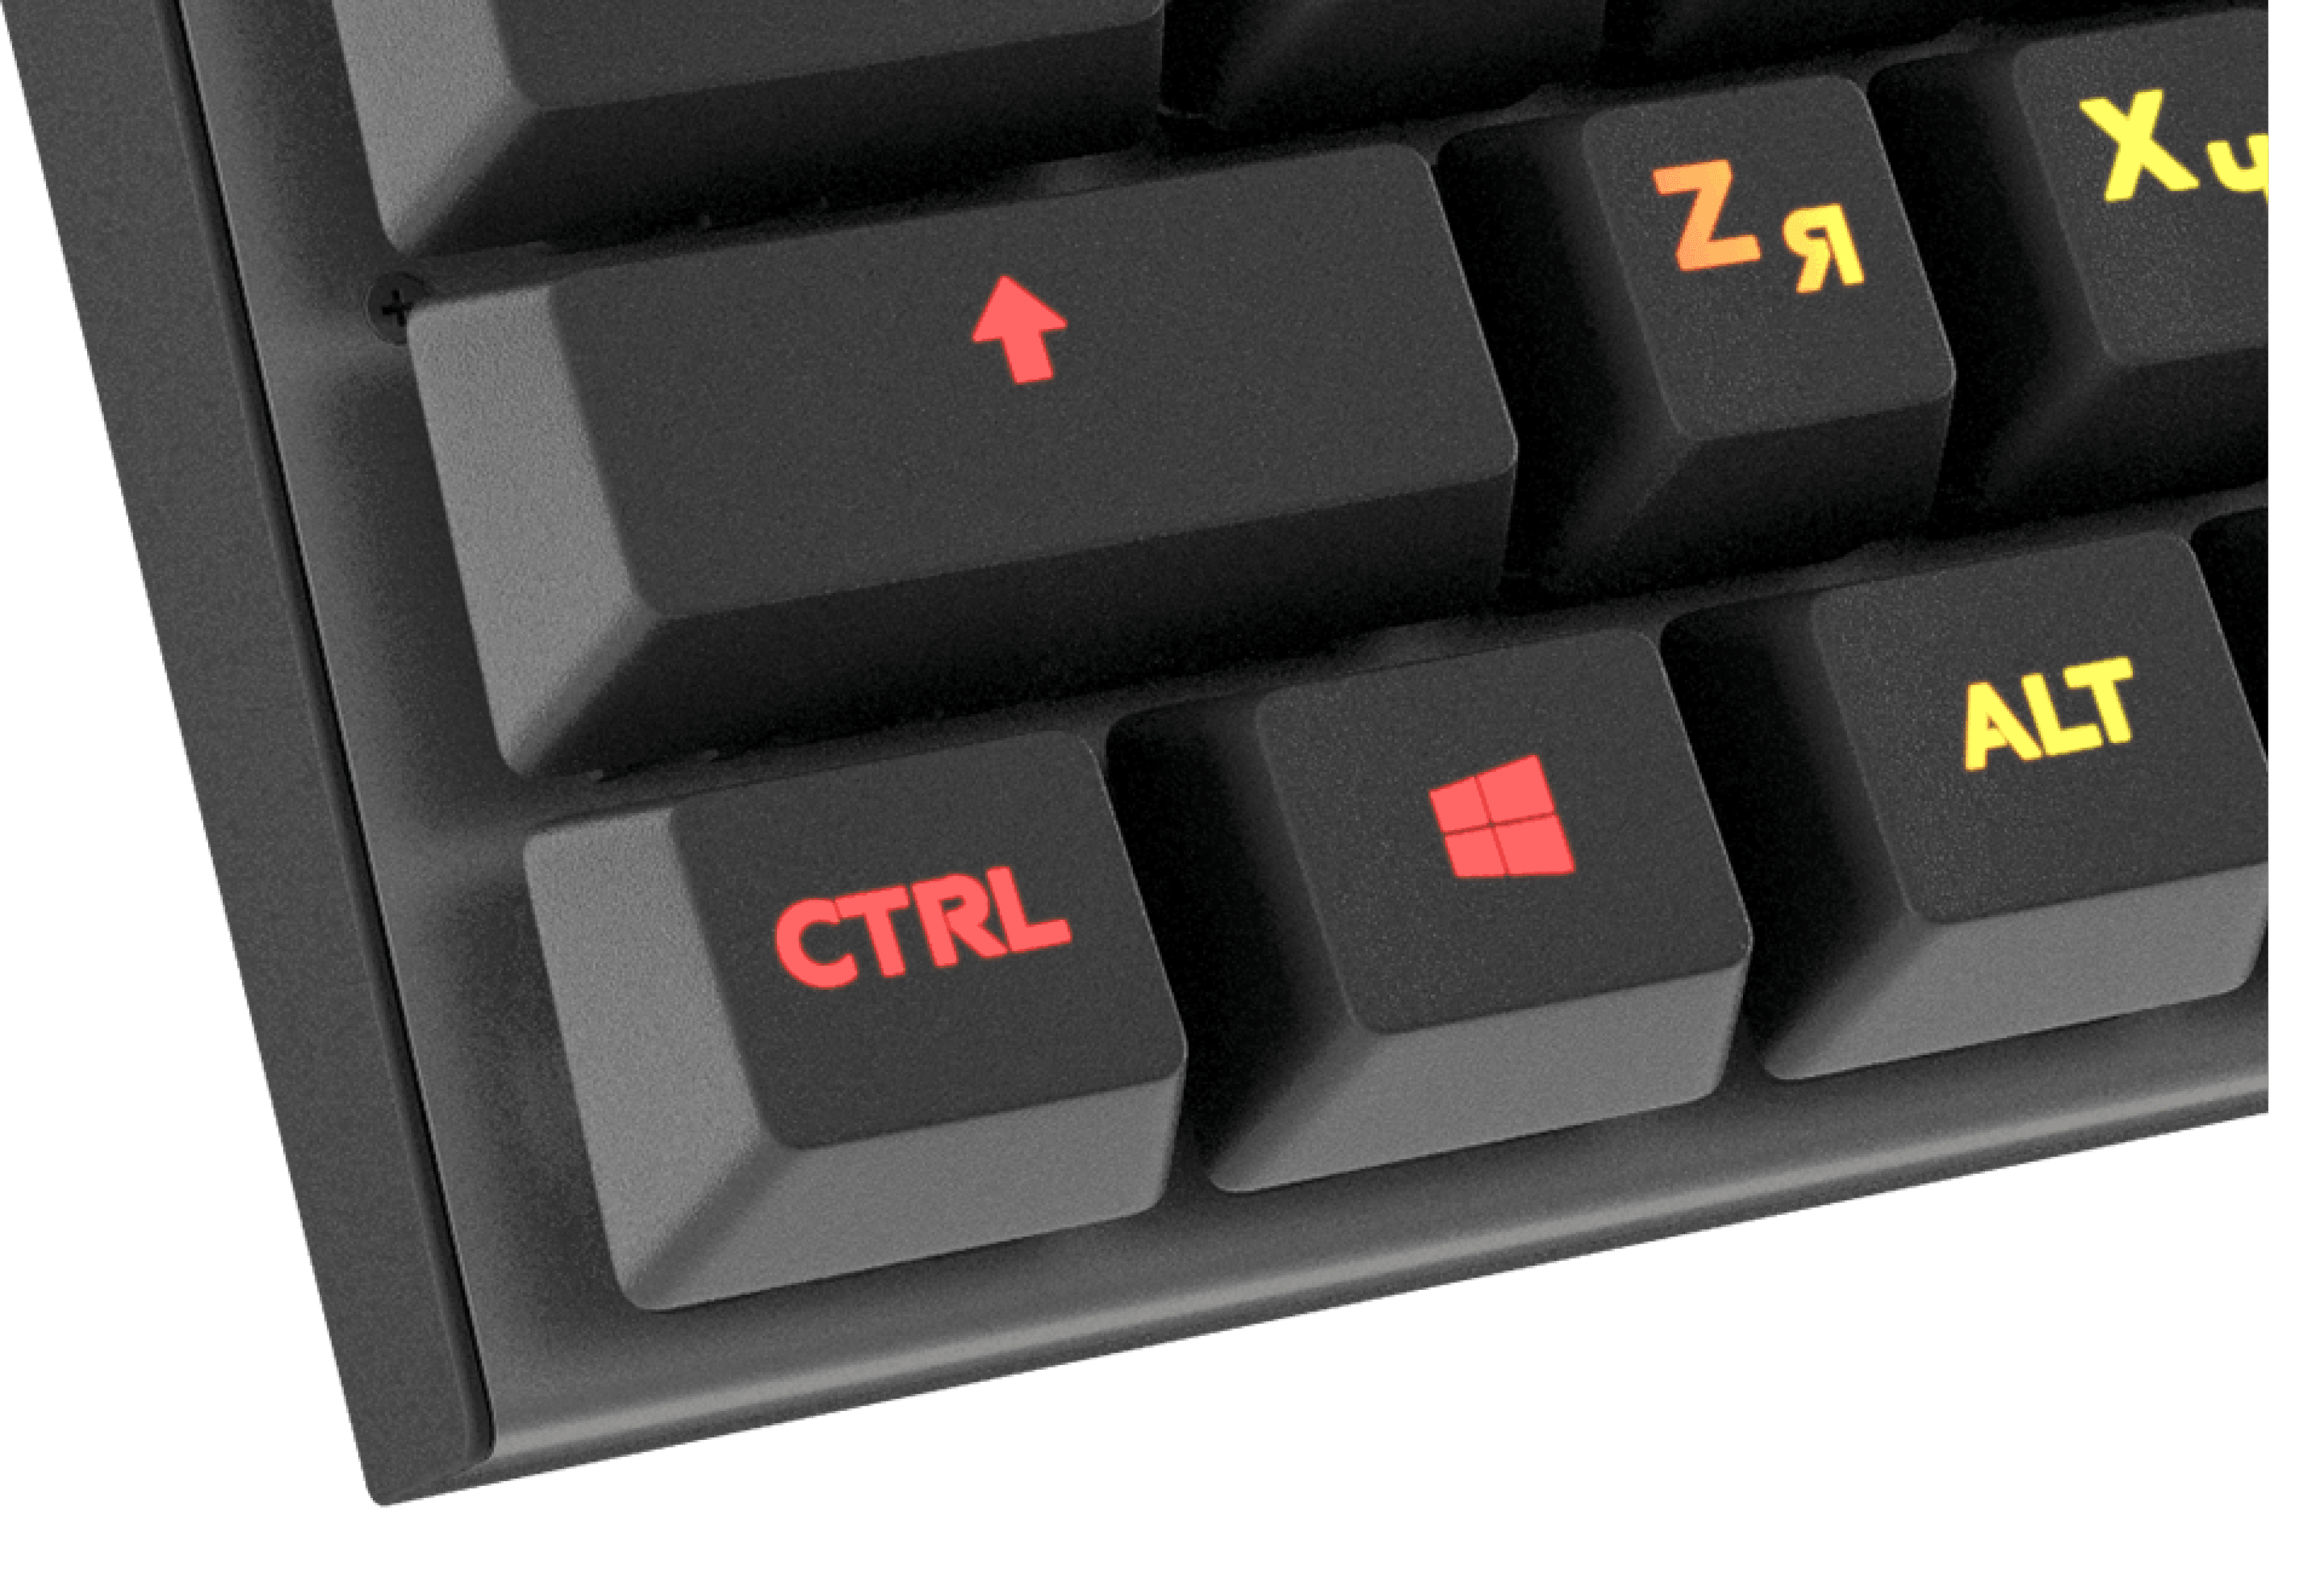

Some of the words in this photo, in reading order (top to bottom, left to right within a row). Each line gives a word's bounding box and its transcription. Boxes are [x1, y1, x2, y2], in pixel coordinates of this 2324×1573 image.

[2079, 88, 2200, 202] X
[1652, 159, 1762, 272] Z
[1781, 202, 1865, 294] Я
[1964, 656, 2134, 771] ALT
[774, 866, 1073, 989] CTRL
